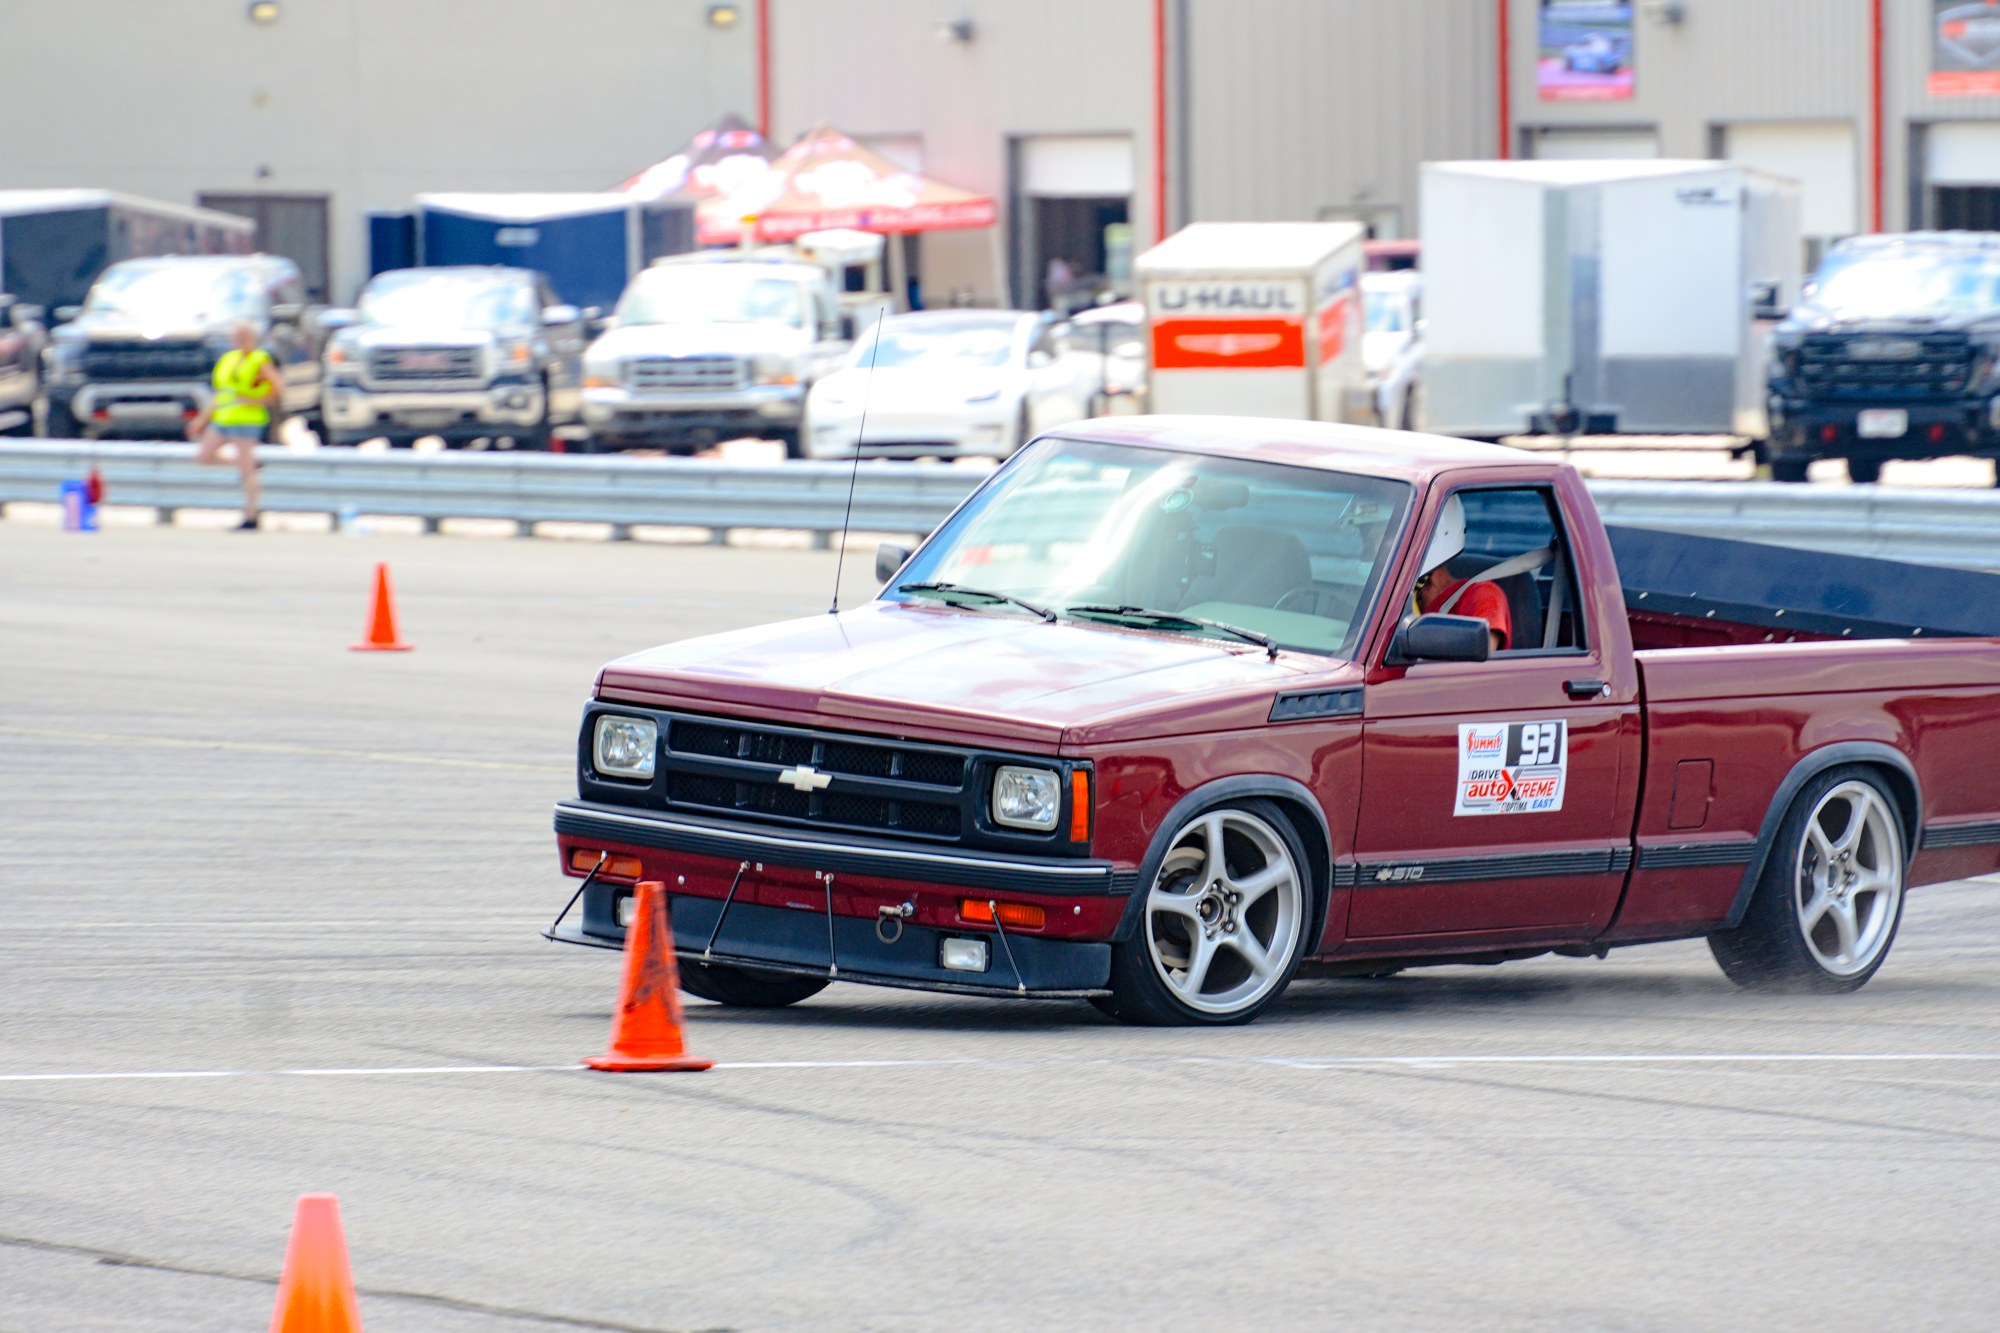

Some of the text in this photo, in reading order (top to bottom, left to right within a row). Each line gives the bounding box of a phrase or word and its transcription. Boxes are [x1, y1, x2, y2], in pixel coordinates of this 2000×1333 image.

[1158, 287, 1295, 310] U-HAUL
[1519, 723, 1557, 765] 93
[1472, 769, 1501, 779] DRIVE
[1532, 798, 1554, 809] EAST
[1391, 867, 1424, 880] S10
